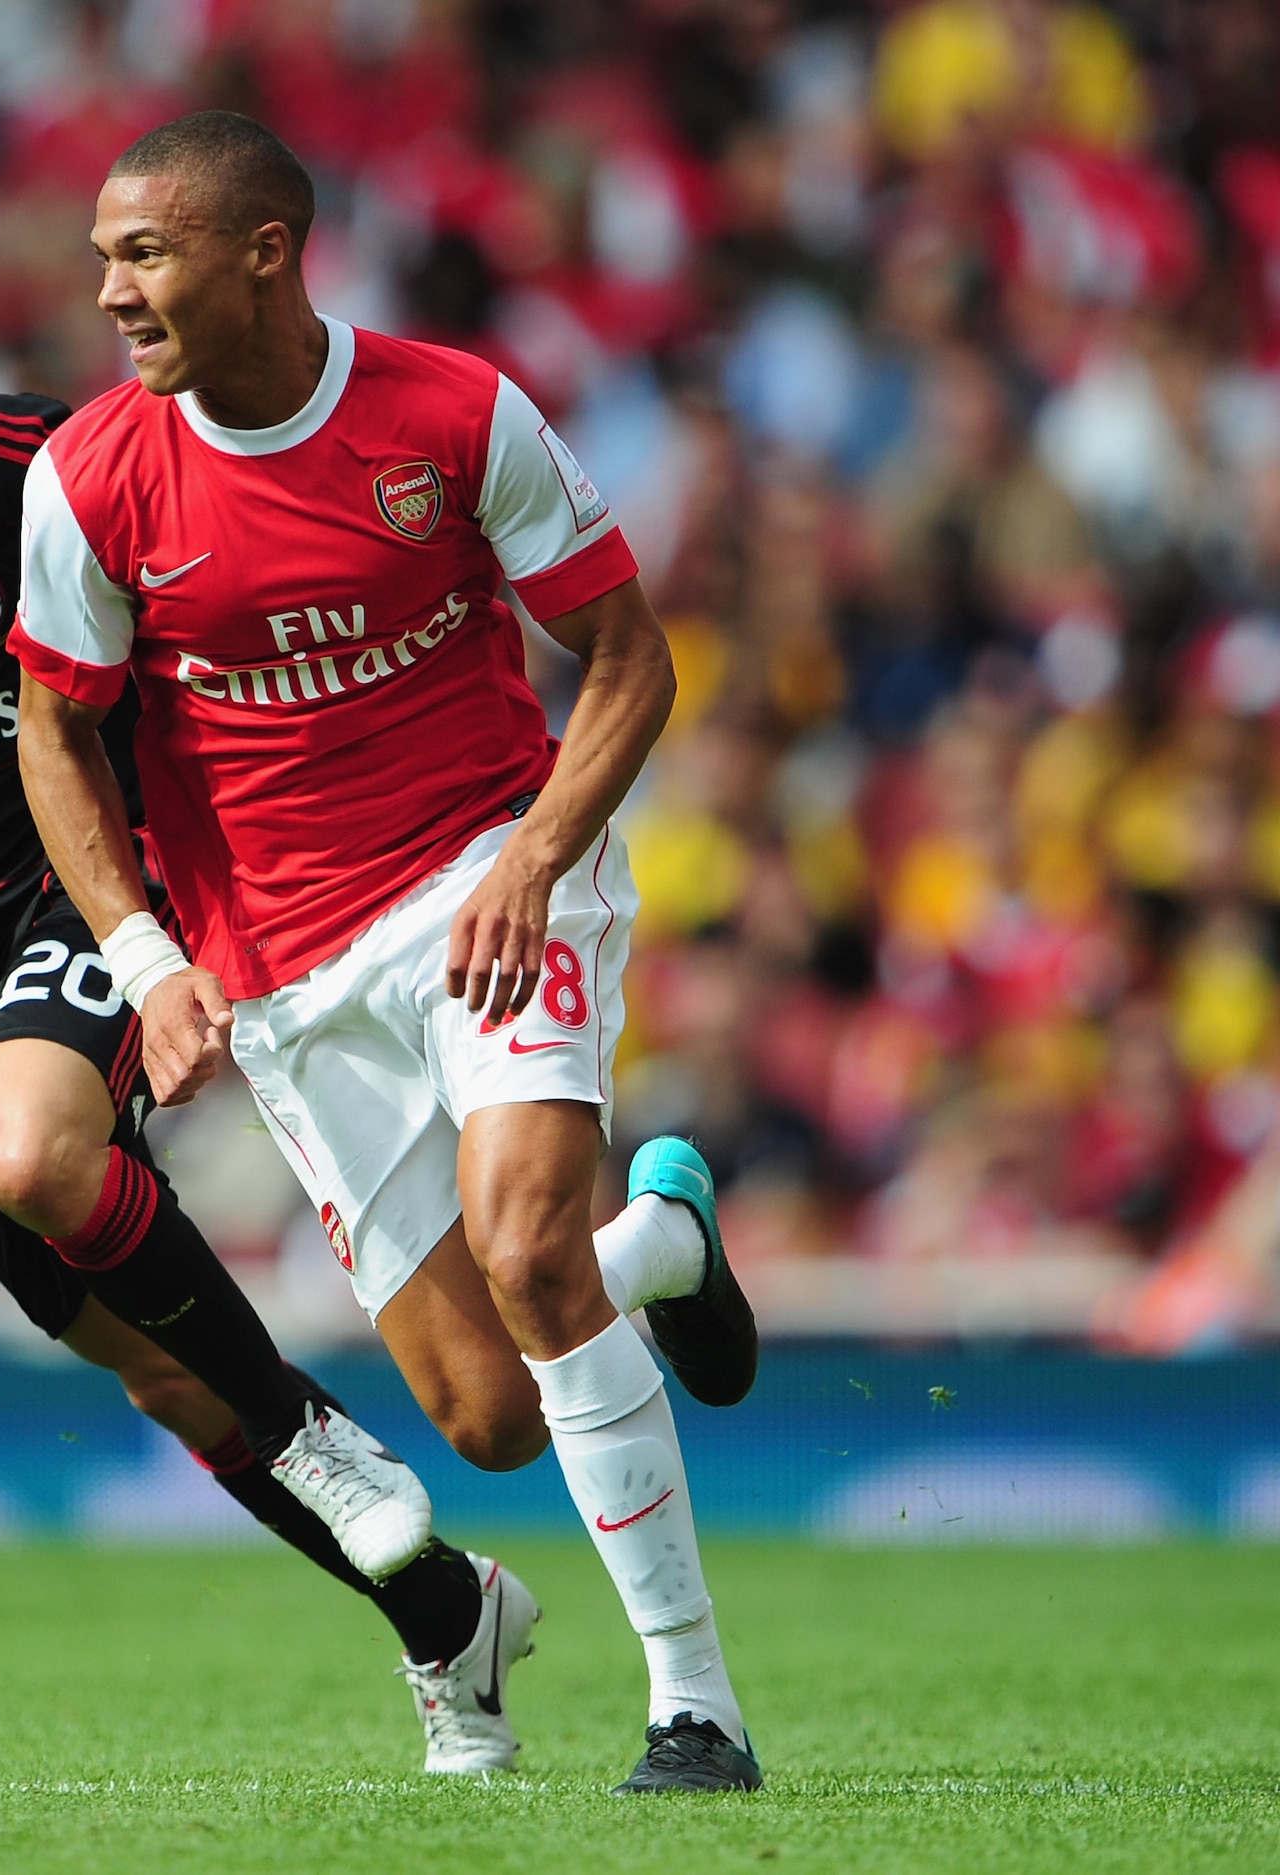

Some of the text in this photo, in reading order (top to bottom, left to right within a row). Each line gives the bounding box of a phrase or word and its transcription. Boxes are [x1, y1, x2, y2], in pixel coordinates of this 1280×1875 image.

[385, 472, 430, 498] Arsenal
[176, 591, 470, 705] Emirates
[266, 603, 366, 654] Fly
